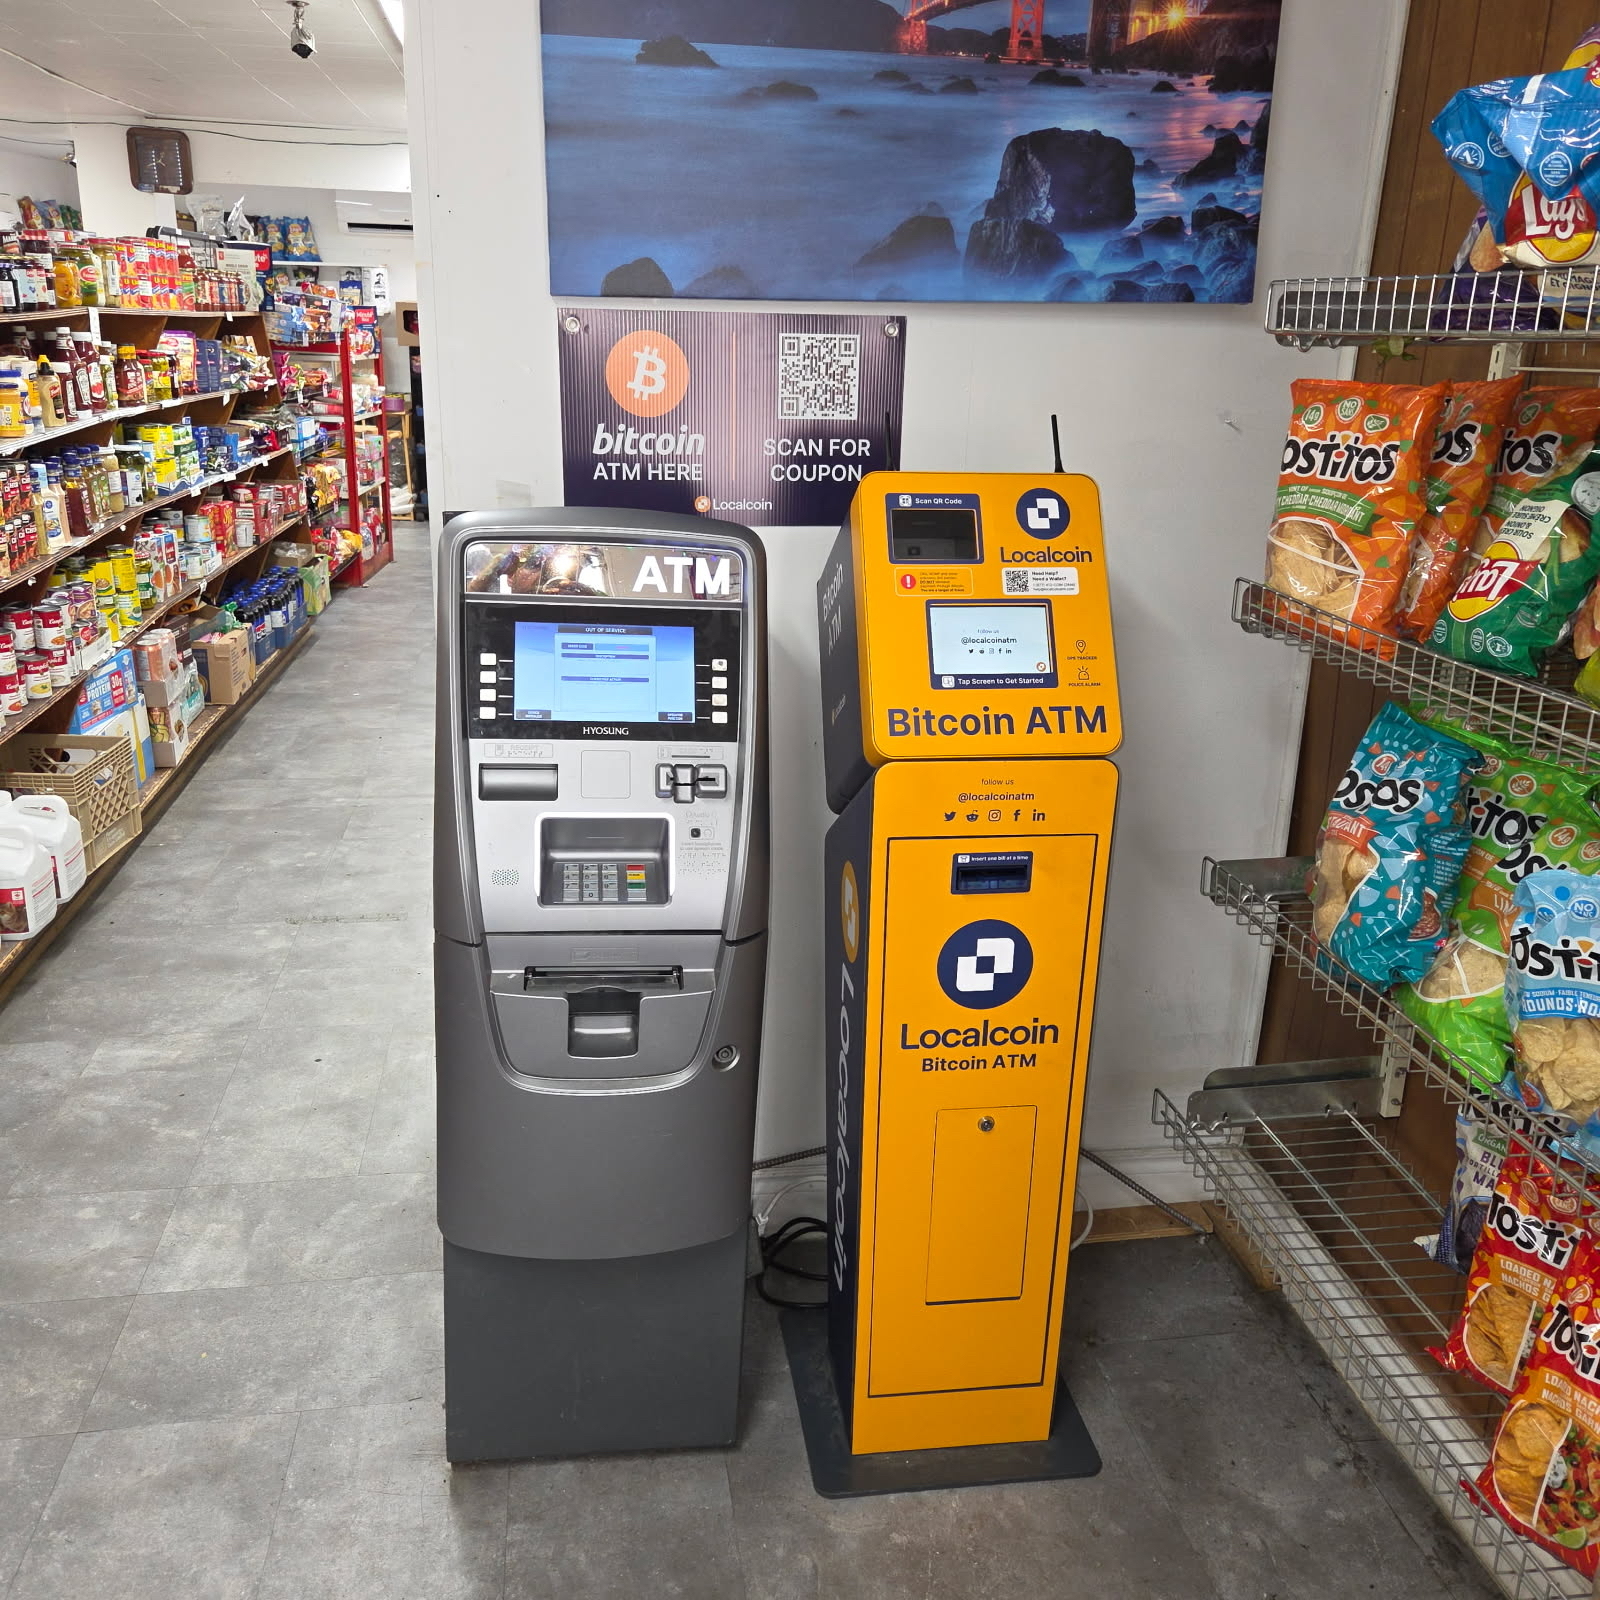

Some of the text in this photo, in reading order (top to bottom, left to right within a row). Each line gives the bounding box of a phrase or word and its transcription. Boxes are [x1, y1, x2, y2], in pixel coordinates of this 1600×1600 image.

[1522, 184, 1587, 239] Lays
[1551, 278, 1560, 287] ET
[1343, 401, 1357, 409] NO
[1305, 409, 1320, 420] 14g
[592, 423, 705, 456] bitcoin
[764, 438, 871, 456] SCAN FOR
[593, 463, 703, 480] ATM HERE
[770, 464, 862, 482] COUPON
[713, 498, 773, 511] Localcoin
[1514, 528, 1534, 540] SOUR
[1000, 546, 1092, 564] Localcoin
[632, 555, 730, 595] ATM
[823, 563, 844, 622] Bitcoin
[828, 604, 842, 656] ATM
[961, 637, 1017, 645] @localcoinatm
[888, 706, 1107, 737] Bitcoin ATM
[583, 727, 629, 735] HYOSUNG
[958, 792, 1035, 803] @localcoinatm
[1574, 903, 1594, 912] NO
[901, 1018, 1059, 1050] Localcoin
[922, 1054, 1037, 1072] Bitcoin ATM
[833, 962, 855, 1292] Localcoin
[1501, 1259, 1540, 1281] LOADED
[1501, 1273, 1540, 1297] NACHOS
